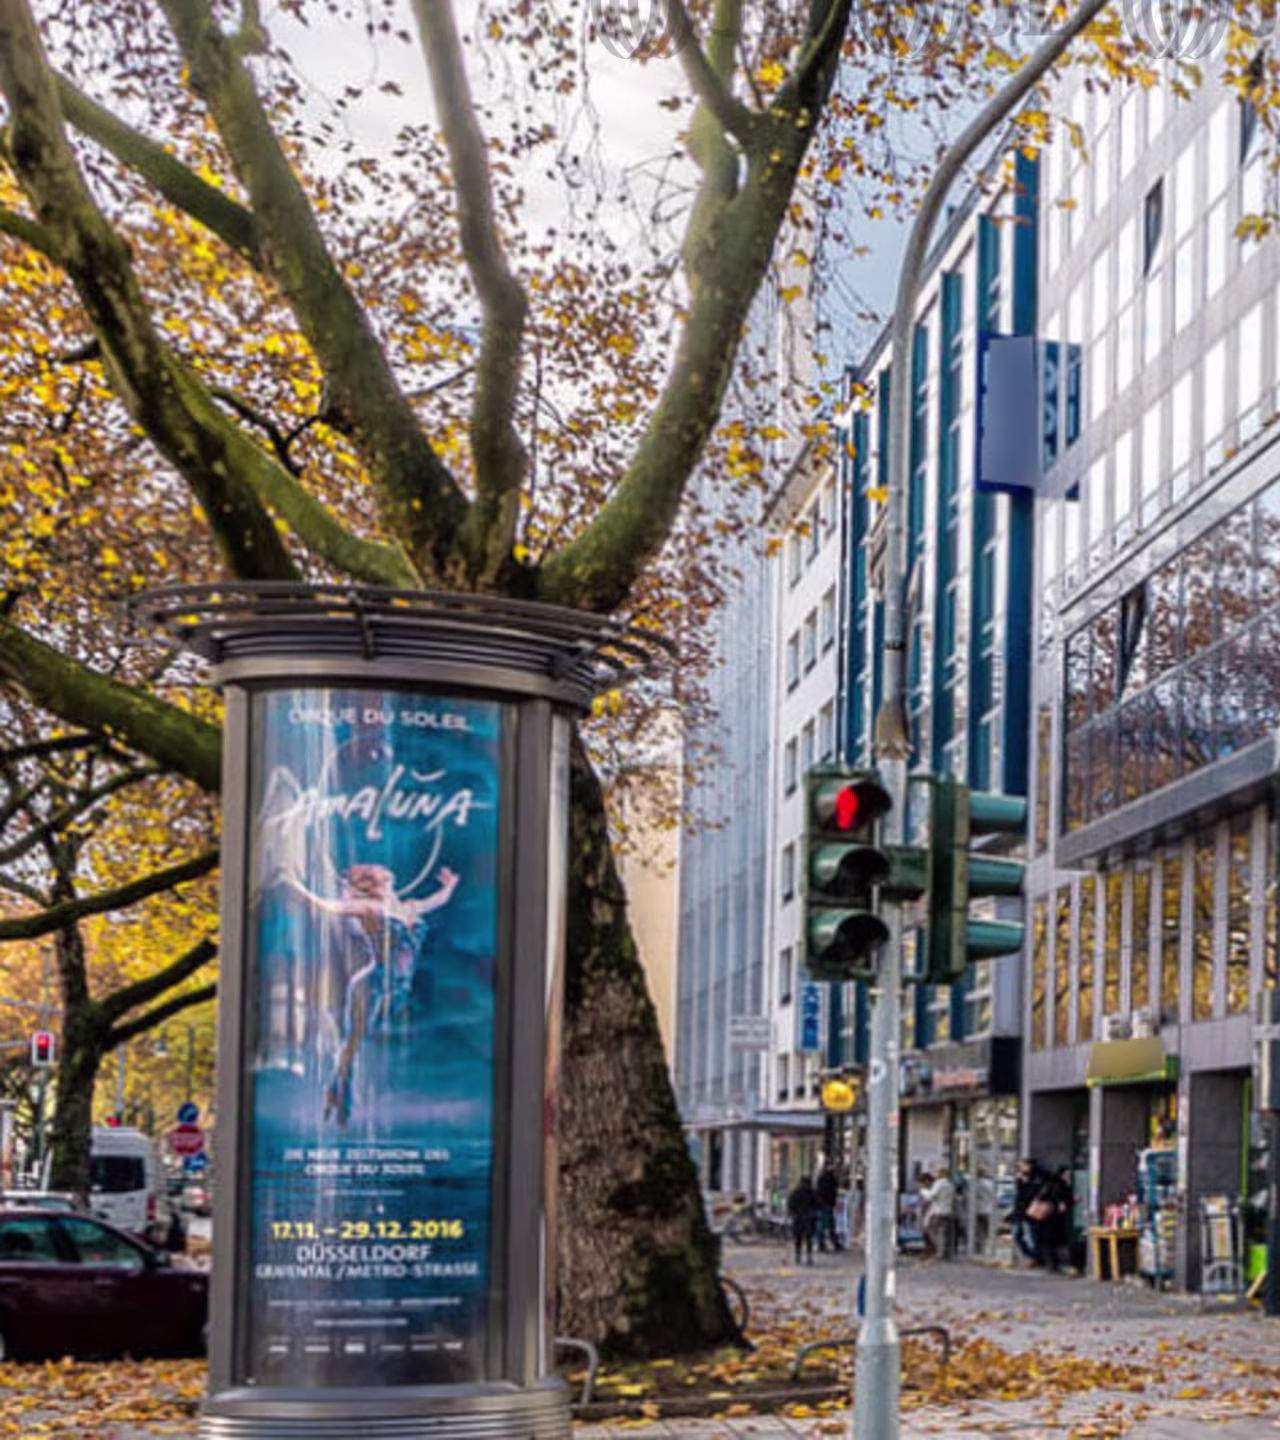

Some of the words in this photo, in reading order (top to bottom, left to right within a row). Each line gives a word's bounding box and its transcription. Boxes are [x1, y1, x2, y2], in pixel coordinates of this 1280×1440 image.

[363, 708, 395, 725] DU
[399, 710, 471, 731] SOLEIL
[296, 1242, 432, 1262] DÜSSELDORF
